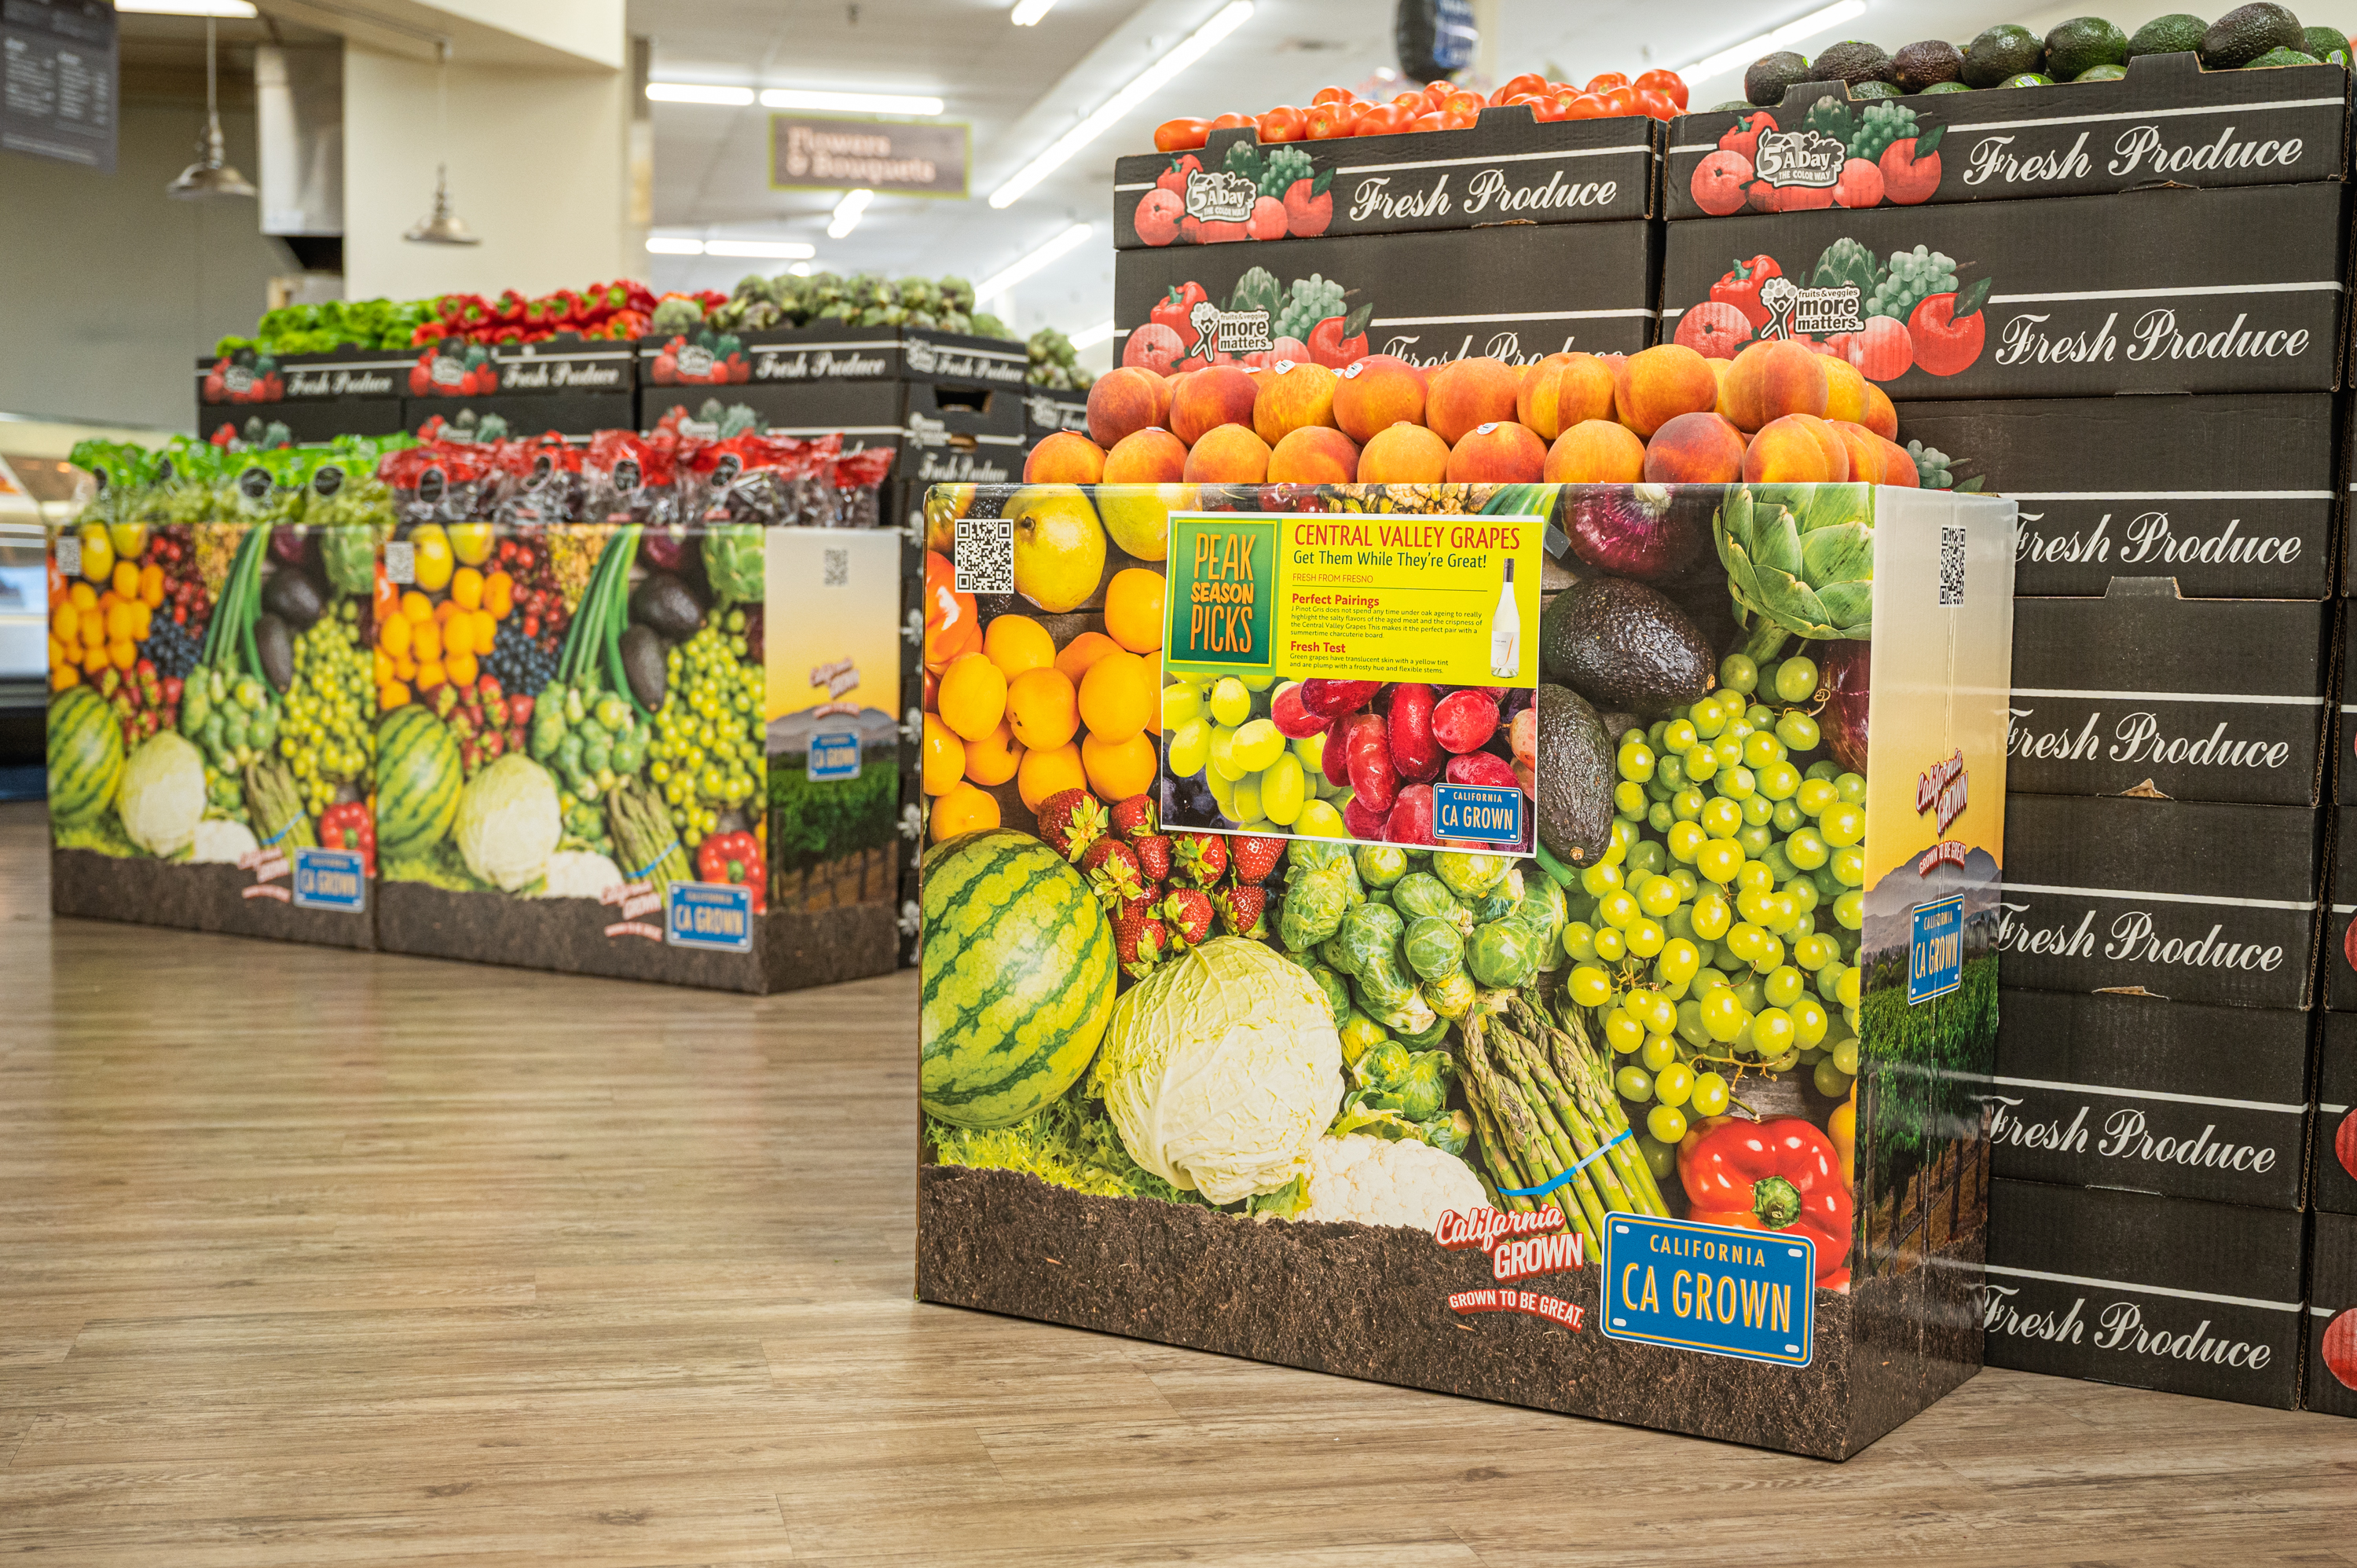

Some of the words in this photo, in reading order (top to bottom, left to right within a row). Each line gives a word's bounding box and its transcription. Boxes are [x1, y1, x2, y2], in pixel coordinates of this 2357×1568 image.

[1963, 132, 2092, 185] Fresh
[2108, 125, 2303, 176] Produce
[1779, 170, 1791, 180] THE
[1792, 170, 1813, 180] COLOR
[1814, 170, 1831, 181] WAY
[1204, 207, 1214, 216] THE
[1215, 206, 1232, 216] COLOR
[1232, 207, 1246, 217] WAY
[1350, 174, 1452, 222] Fresh
[1464, 168, 1617, 214] Produce
[1798, 298, 1857, 316] more
[1798, 316, 1857, 330] matters
[1220, 336, 1266, 349] matters
[1221, 321, 1266, 336] more
[1995, 312, 2118, 365] Fresh
[2127, 308, 2309, 361] Produce
[1294, 524, 1373, 547] CENTRAL
[1379, 526, 1445, 548] VALLEY
[1450, 526, 1520, 550] GRAPES
[2121, 511, 2302, 564] Produce
[1193, 533, 1256, 581] PEAK
[1293, 550, 1314, 564] Get
[1318, 550, 1352, 565] Them
[1357, 551, 1393, 566] While
[1397, 552, 1443, 570] They’re
[1447, 553, 1486, 569] Great!
[1190, 581, 1255, 605] SEASON
[1292, 573, 1317, 582] FRESH
[1318, 573, 1341, 583] FROM
[1342, 574, 1373, 583] FRESNO
[1292, 593, 1332, 605] Perfect
[1335, 594, 1380, 609] Pairings
[1190, 604, 1253, 654] PICKS
[1290, 640, 1320, 652] Fresh
[1323, 642, 1346, 654] Test
[2109, 712, 2289, 768] Produce
[1453, 791, 1502, 803] CALIFORNIA
[1915, 748, 1963, 812] California
[1442, 804, 1459, 826] CA
[1463, 806, 1513, 830] GROWN
[1937, 771, 1968, 834] GROWN
[1919, 846, 1939, 875] GROWN
[1938, 842, 1945, 861] TO
[1945, 841, 1952, 859] BE
[1951, 841, 1966, 866] GREAT.
[1923, 910, 1953, 931] CALIFORNIA
[1915, 941, 1926, 980] CA
[1929, 932, 1959, 975] GROWN
[2105, 910, 2283, 972] Produce
[2099, 1108, 2276, 1173] Produce
[1436, 1203, 1565, 1252] California
[1494, 1232, 1583, 1280] GROWN
[1649, 1234, 1765, 1267] CALIFORNIA
[1450, 1291, 1496, 1308] GROWN
[1500, 1291, 1516, 1306] TO
[1519, 1292, 1538, 1310] BE
[1539, 1296, 1584, 1328] GREAT.
[1622, 1262, 1660, 1314] CA
[1673, 1269, 1791, 1333] GROWN
[2094, 1302, 2271, 1370] Produce
